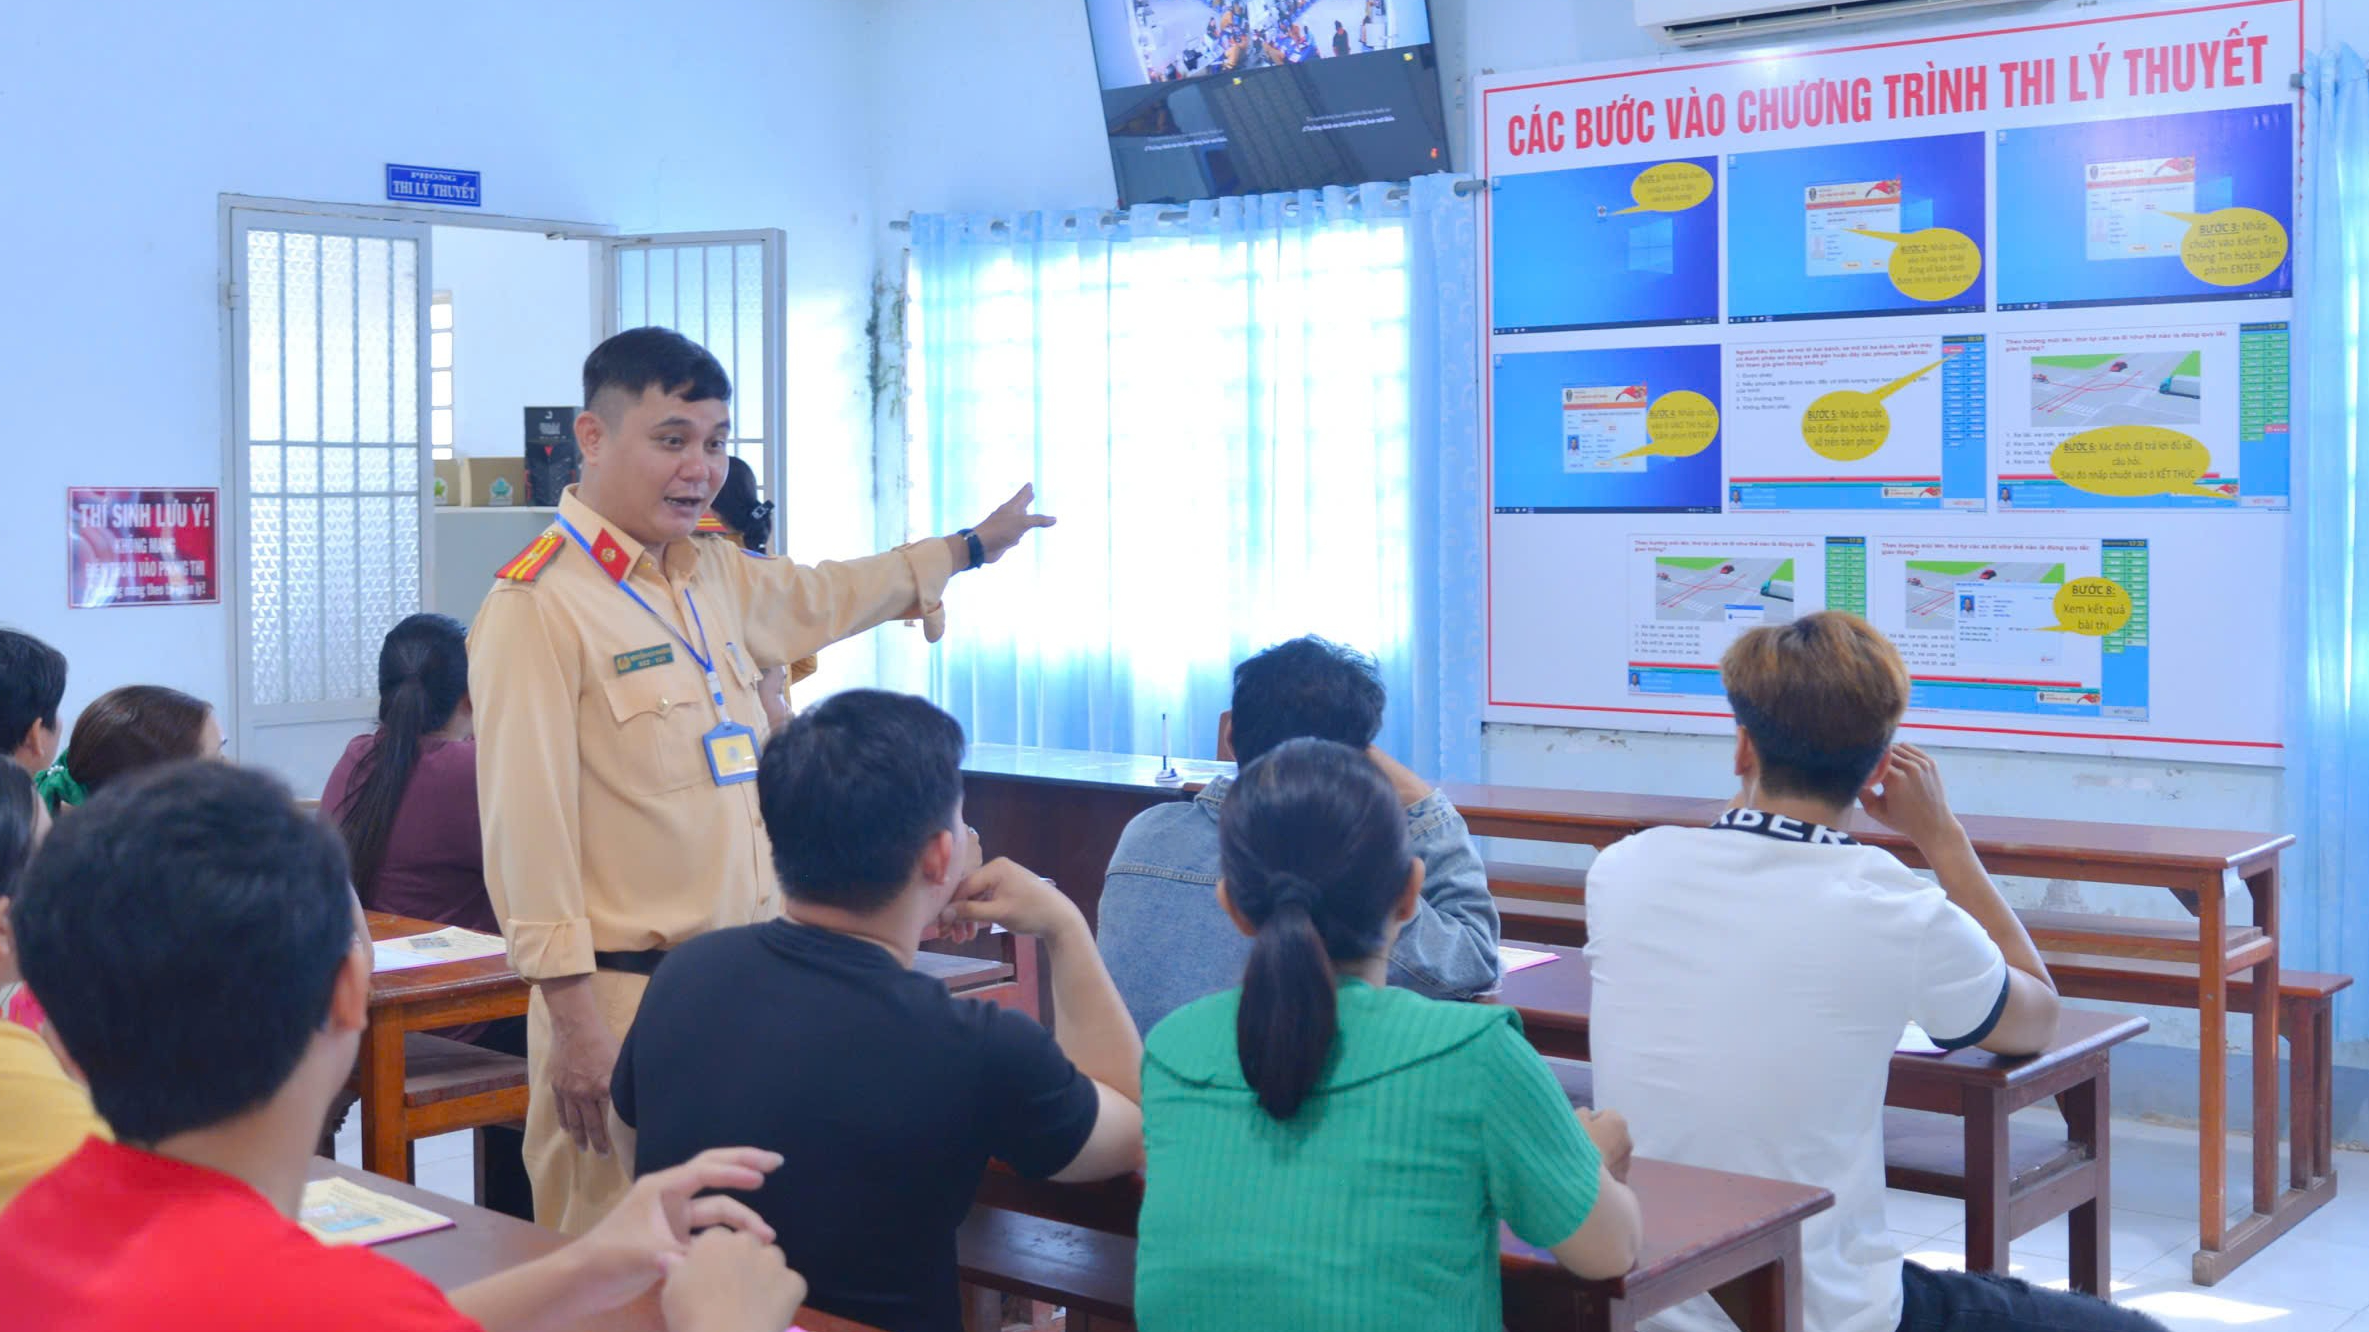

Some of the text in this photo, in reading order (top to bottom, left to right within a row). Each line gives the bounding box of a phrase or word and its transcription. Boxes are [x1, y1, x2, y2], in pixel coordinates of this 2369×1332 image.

[1508, 21, 2268, 156] CÁC BƯỚC VÀO CHƯƠNG TRÌNH THI LÝ THUYẾT
[393, 180, 475, 199] THI LÝ THUYẾT
[79, 497, 210, 528] THÍ SINH LƯU Ý!
[2072, 583, 2116, 594] BƯỚC 8:
[2064, 603, 2126, 616] Xem kết quả
[2078, 620, 2109, 630] bài thi
